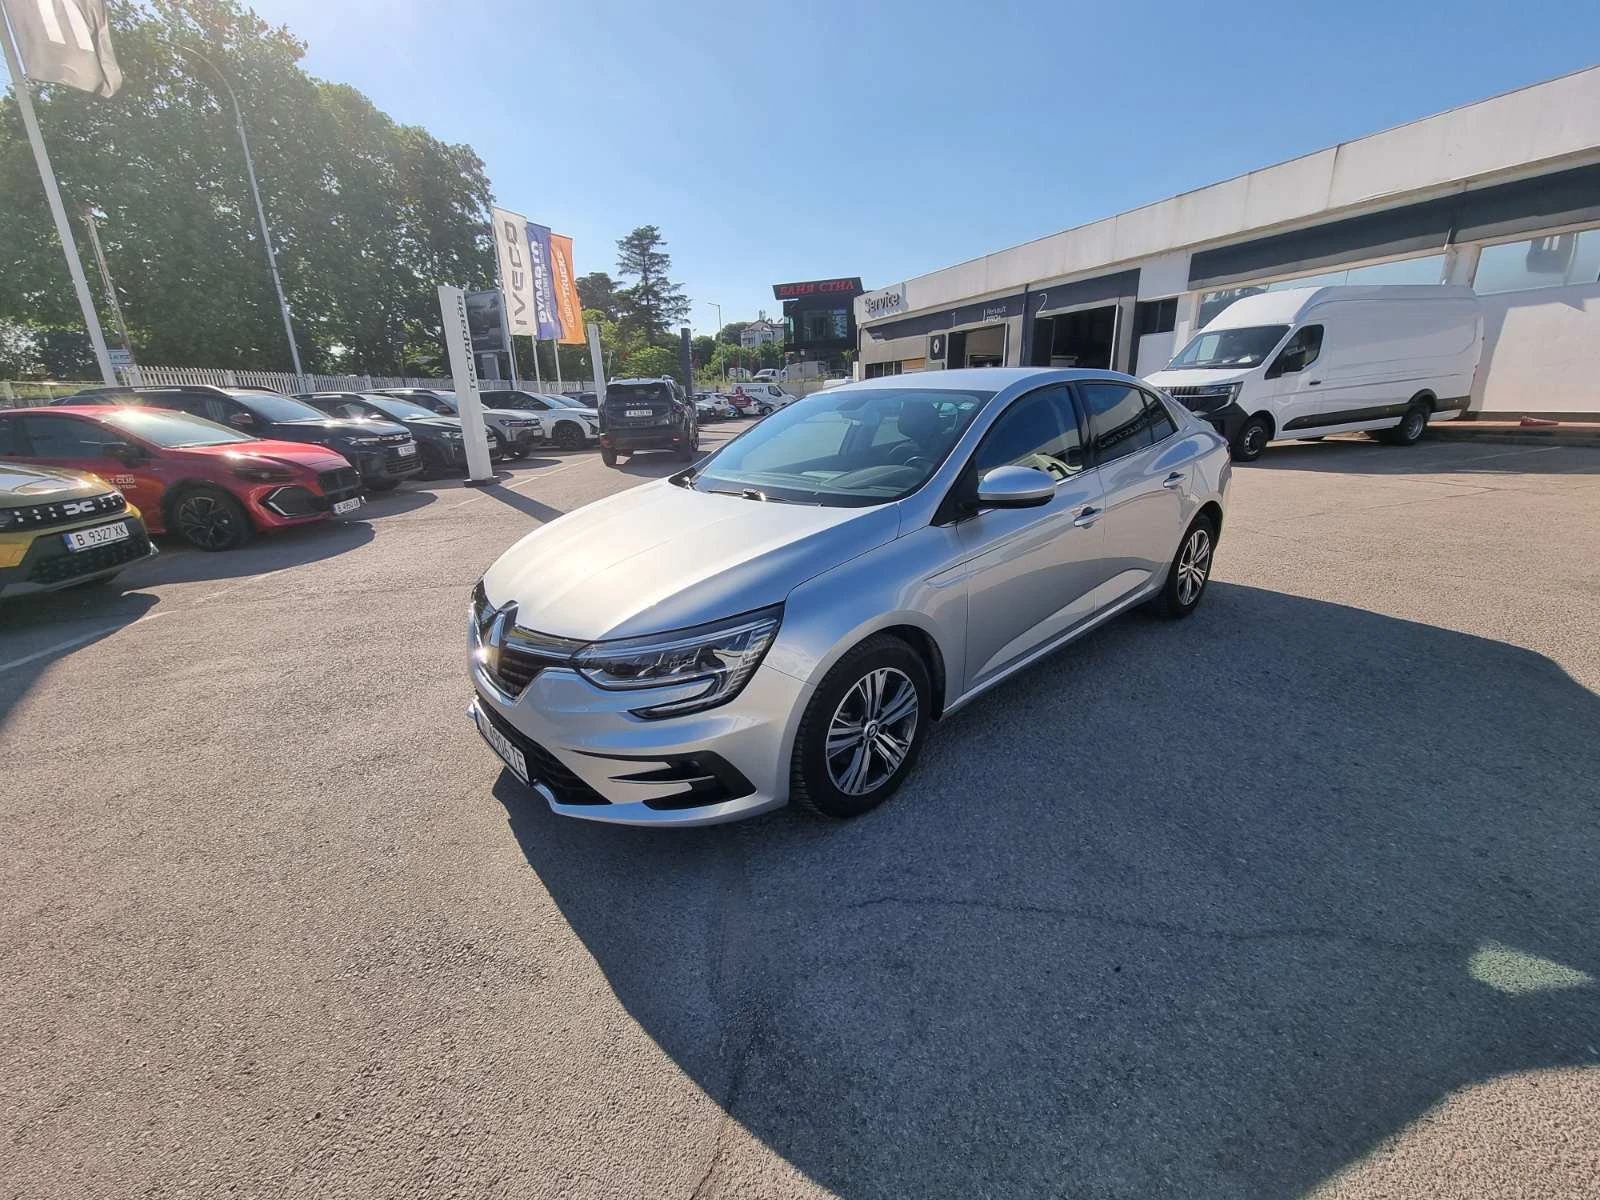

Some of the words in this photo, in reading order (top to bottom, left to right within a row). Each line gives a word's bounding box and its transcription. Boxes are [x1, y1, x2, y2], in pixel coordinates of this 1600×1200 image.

[504, 221, 527, 326] IVECO
[865, 292, 900, 313] Service
[1038, 293, 1048, 313] 2
[76, 535, 85, 546] B
[88, 527, 110, 543] 9327
[114, 523, 127, 537] XK
